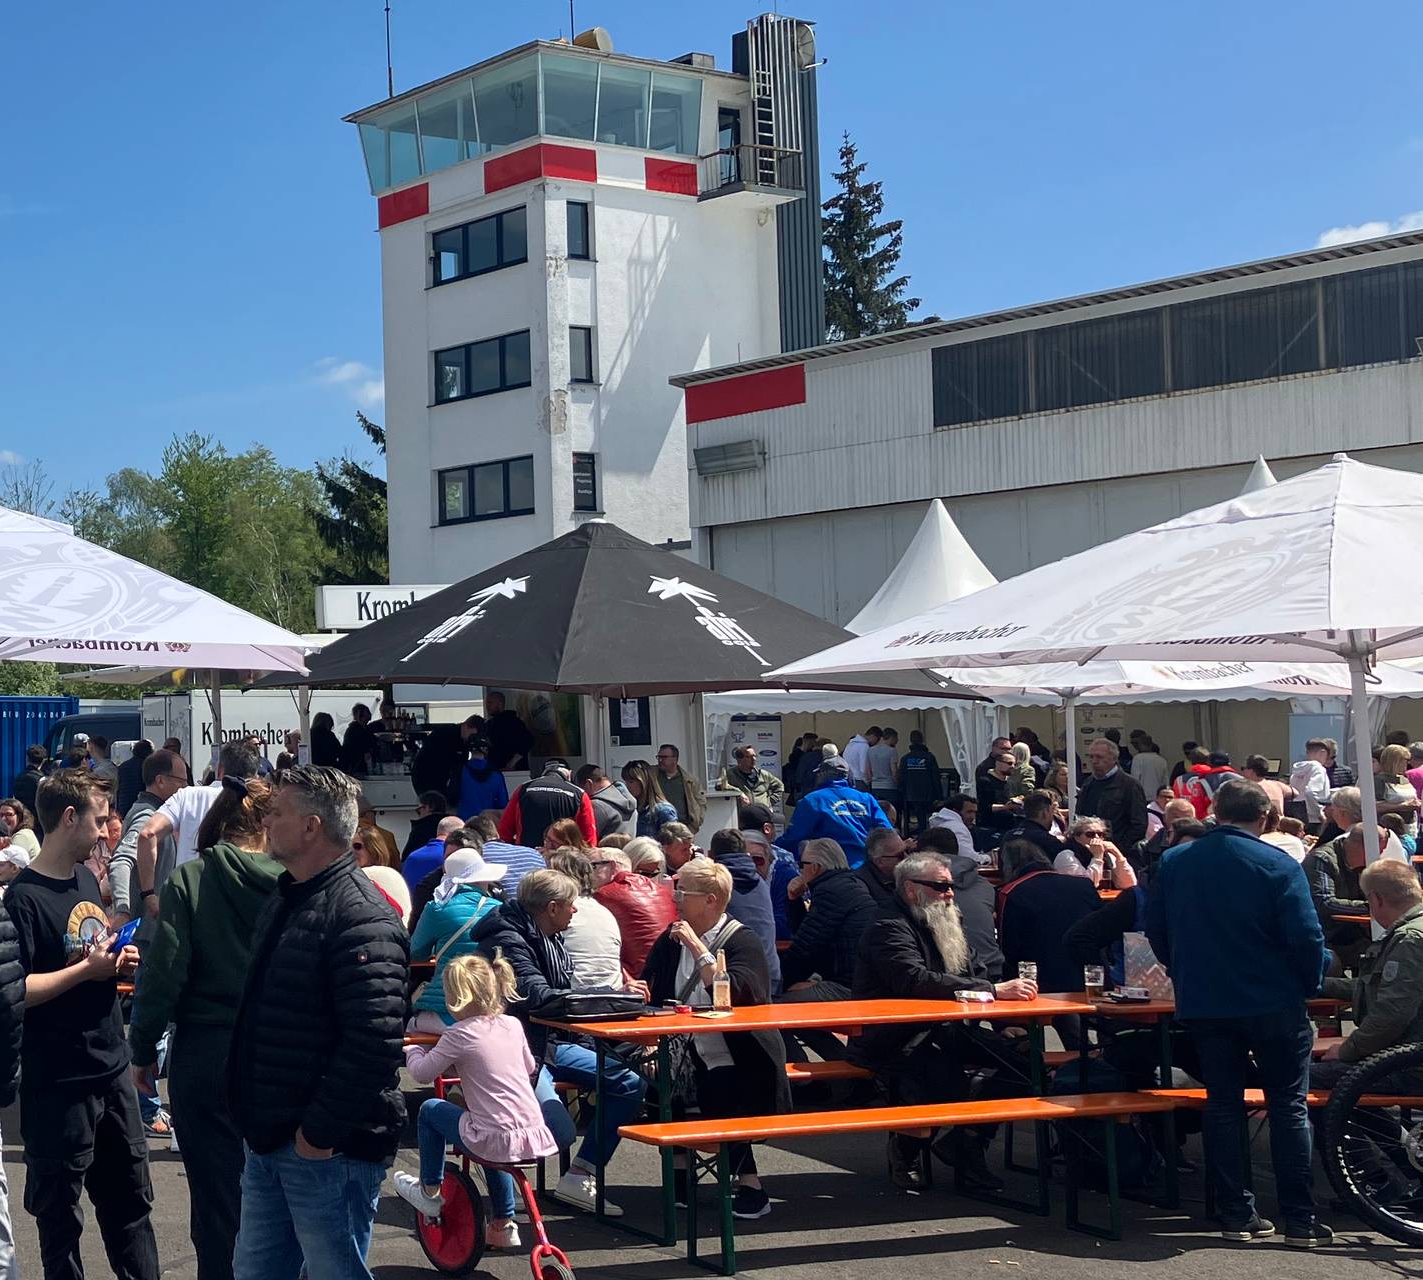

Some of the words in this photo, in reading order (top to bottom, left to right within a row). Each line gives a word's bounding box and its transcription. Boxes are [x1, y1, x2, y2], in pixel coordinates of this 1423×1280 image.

[906, 622, 1029, 646] Krombacher
[1167, 661, 1255, 681] Krombacher
[202, 722, 290, 745] Kombacher
